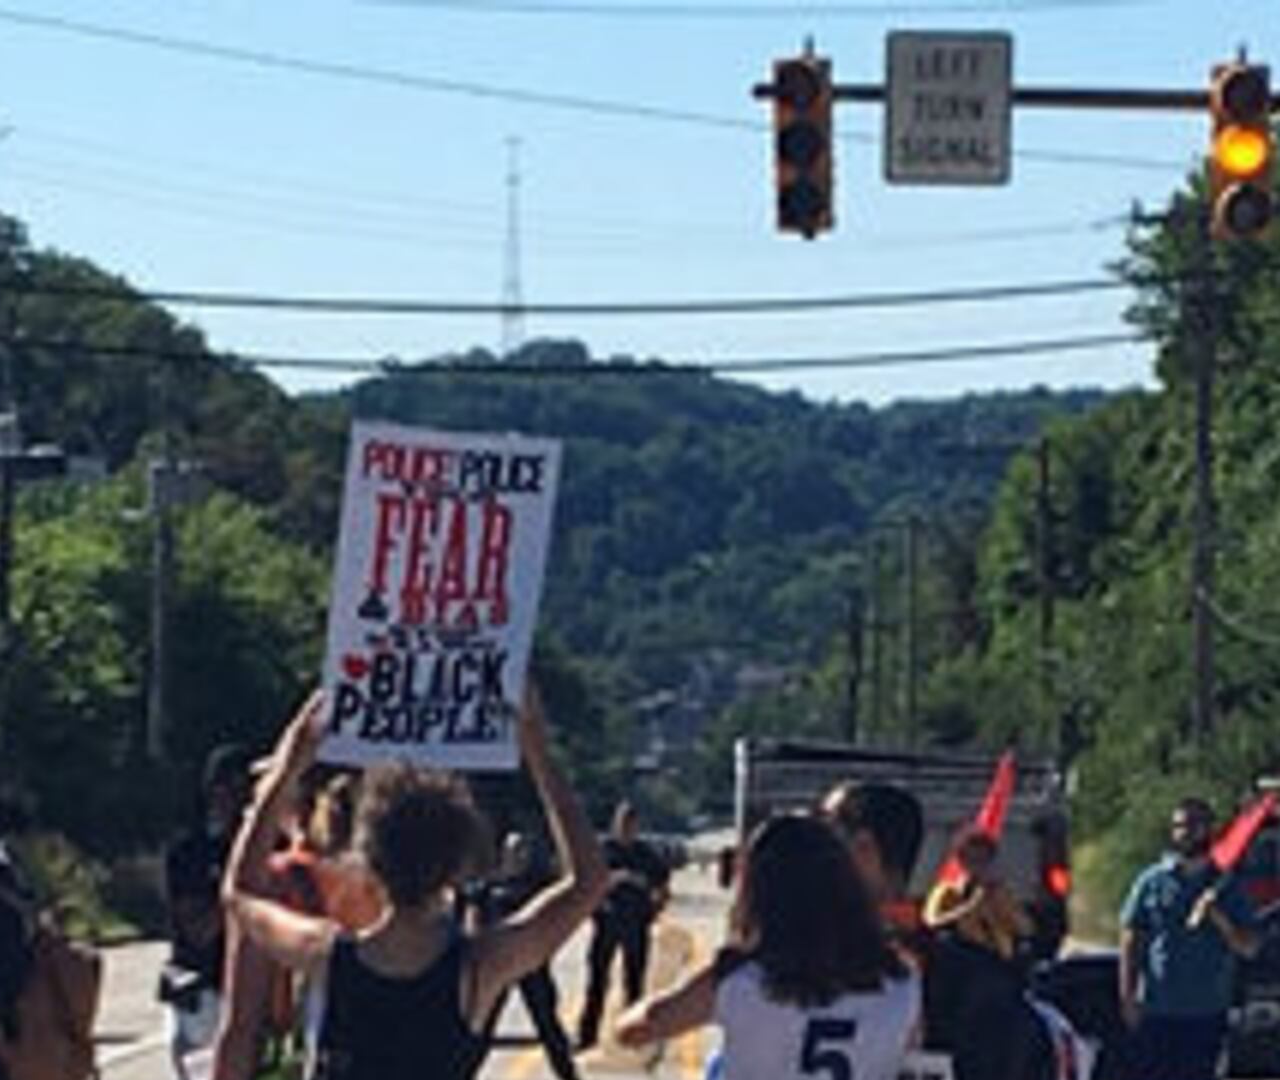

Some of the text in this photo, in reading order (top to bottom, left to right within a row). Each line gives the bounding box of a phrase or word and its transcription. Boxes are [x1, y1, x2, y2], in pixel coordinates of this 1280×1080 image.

[915, 48, 983, 79] LEFT
[913, 95, 984, 121] TURN
[901, 137, 995, 165] SIGNAL
[363, 439, 544, 495] POLICE POLICE
[372, 491, 512, 605] FEAR
[369, 648, 509, 704] BLACK
